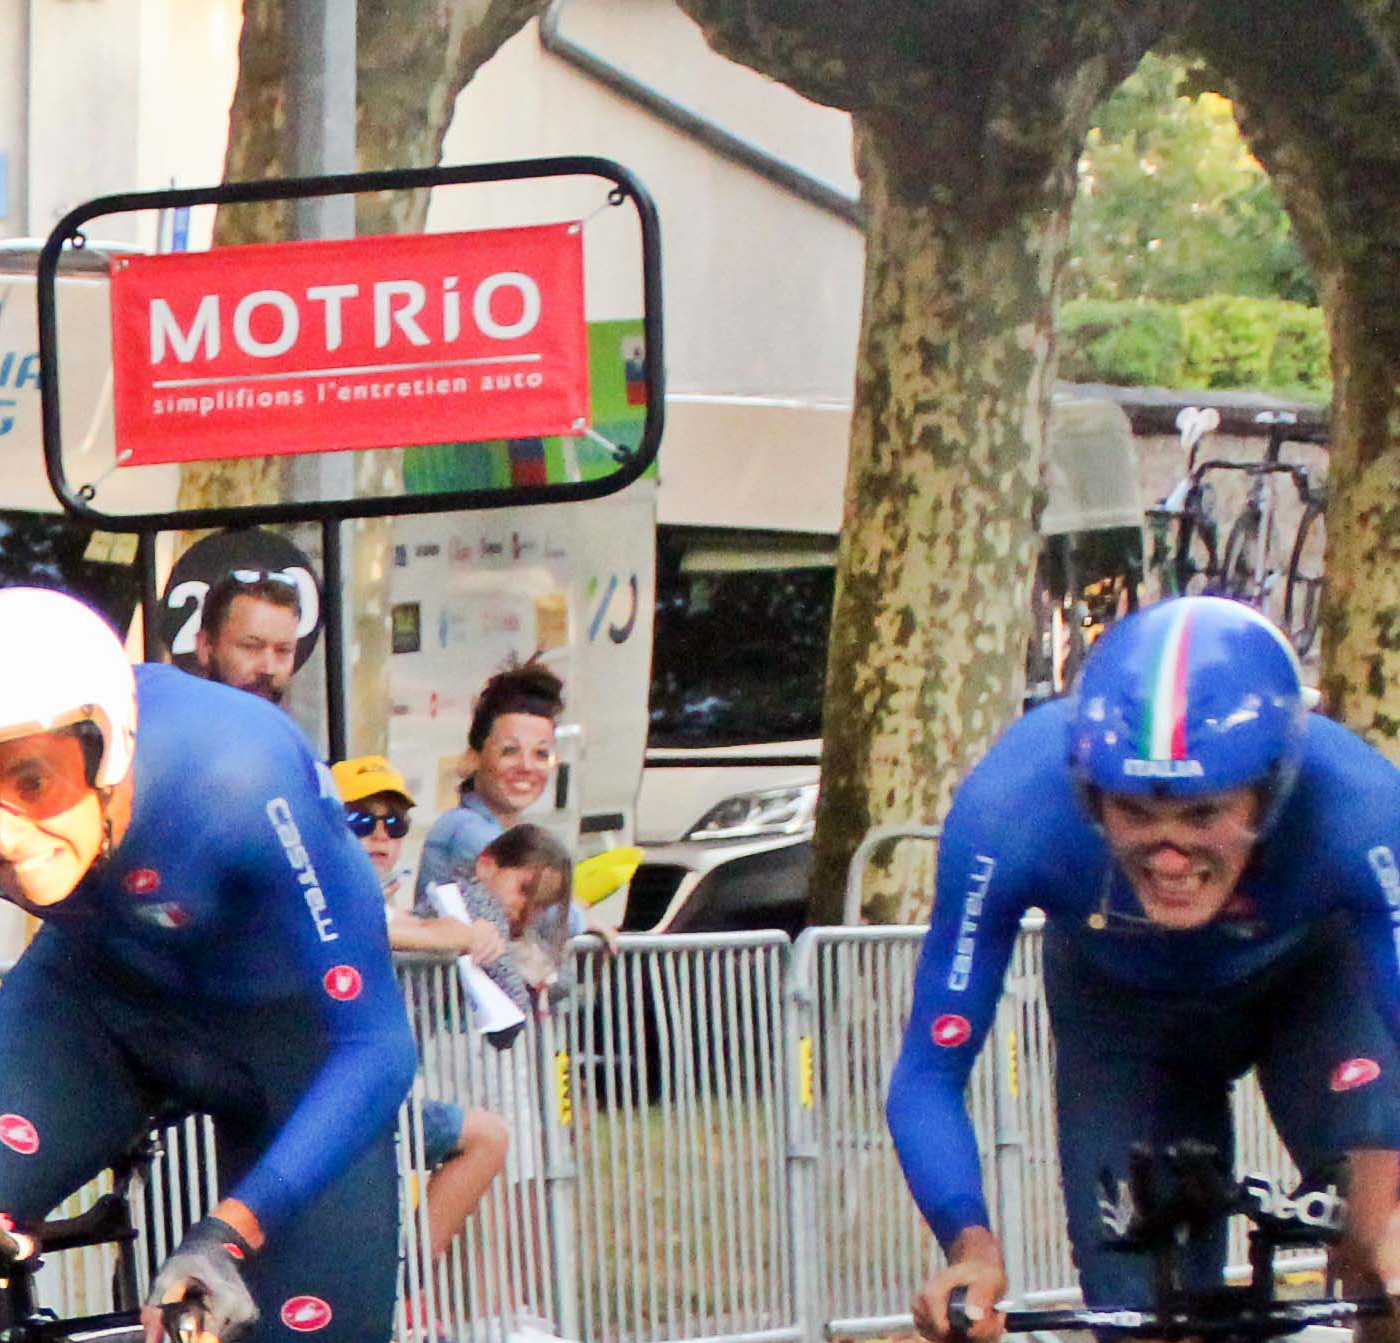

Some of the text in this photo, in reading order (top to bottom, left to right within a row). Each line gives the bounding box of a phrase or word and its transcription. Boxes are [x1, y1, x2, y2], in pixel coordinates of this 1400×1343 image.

[153, 368, 544, 416] simplifions l'entretien auto
